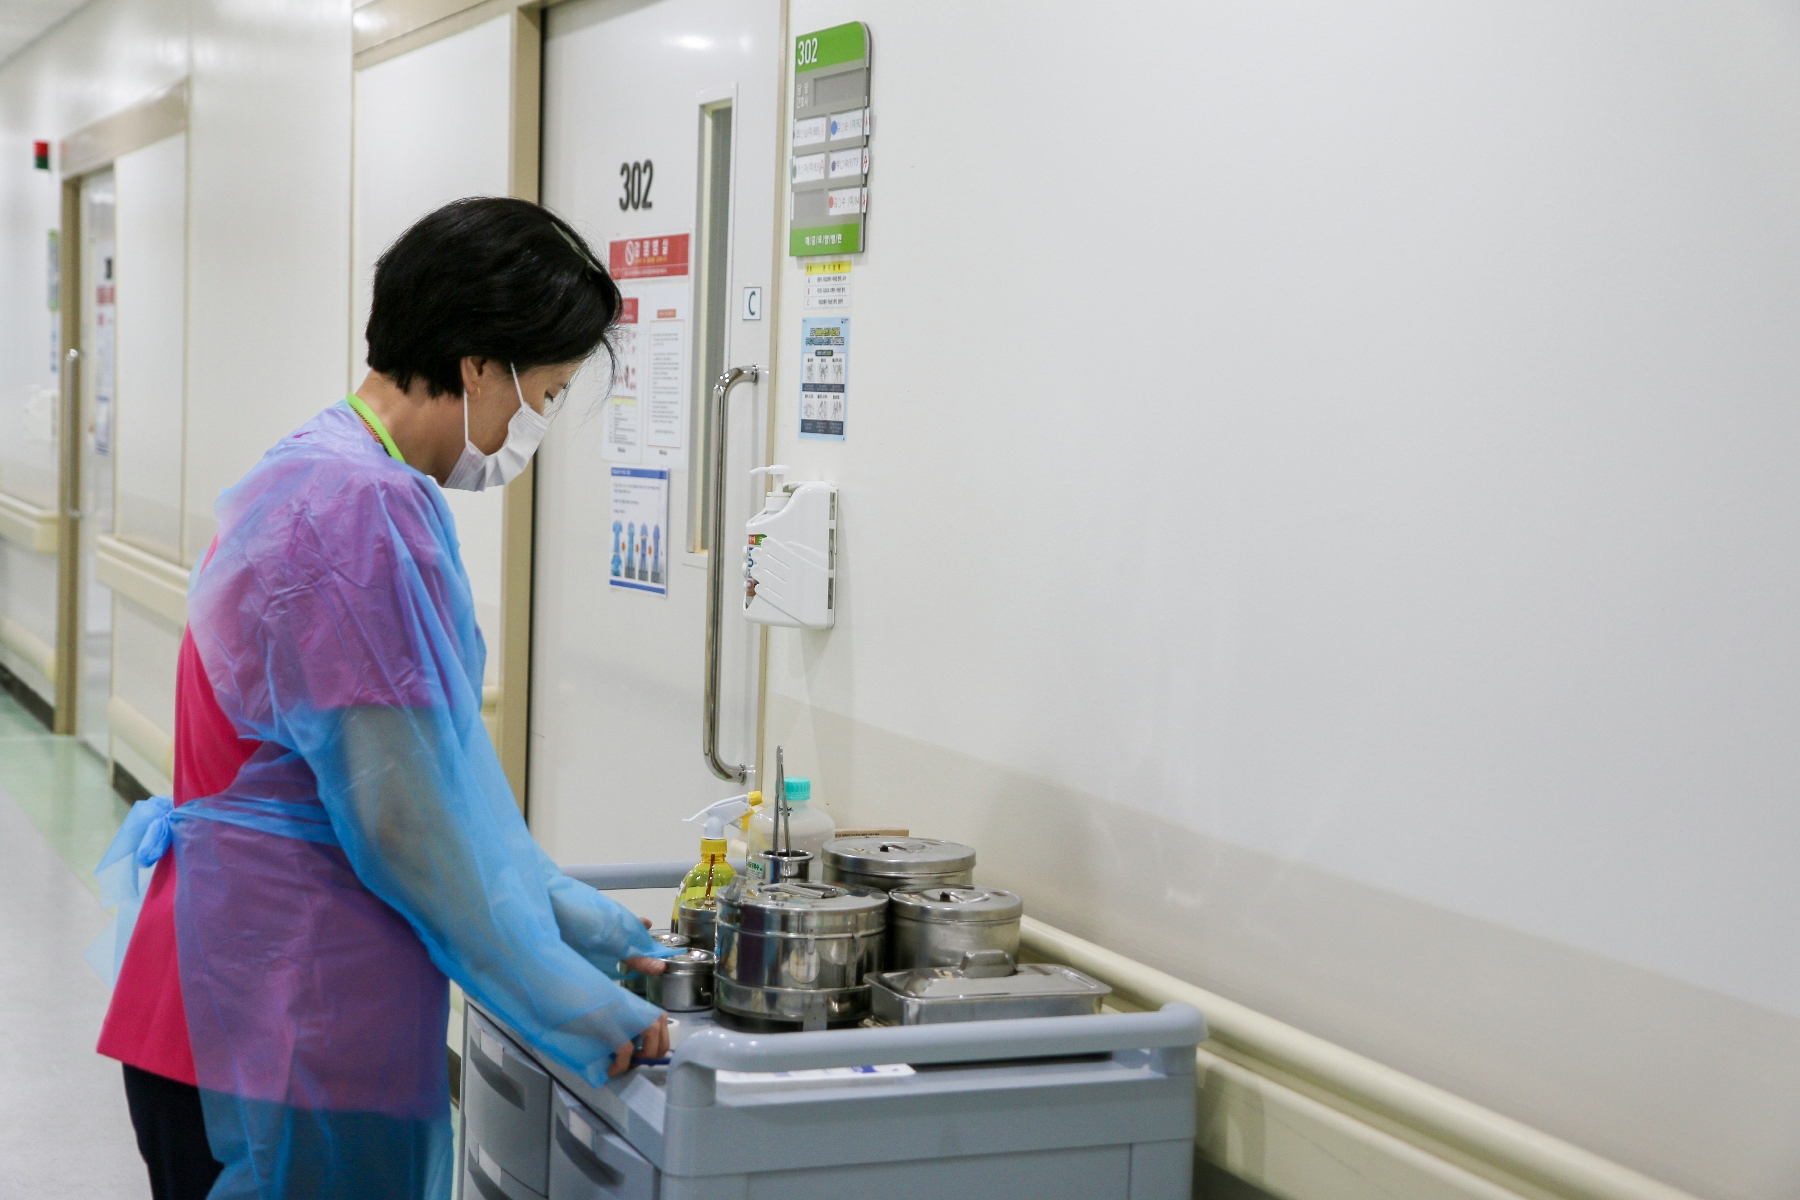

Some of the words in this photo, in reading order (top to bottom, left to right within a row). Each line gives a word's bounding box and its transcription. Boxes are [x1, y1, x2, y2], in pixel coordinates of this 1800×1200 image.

[797, 37, 818, 66] 302
[619, 159, 653, 211] 302
[748, 290, 756, 316] C
